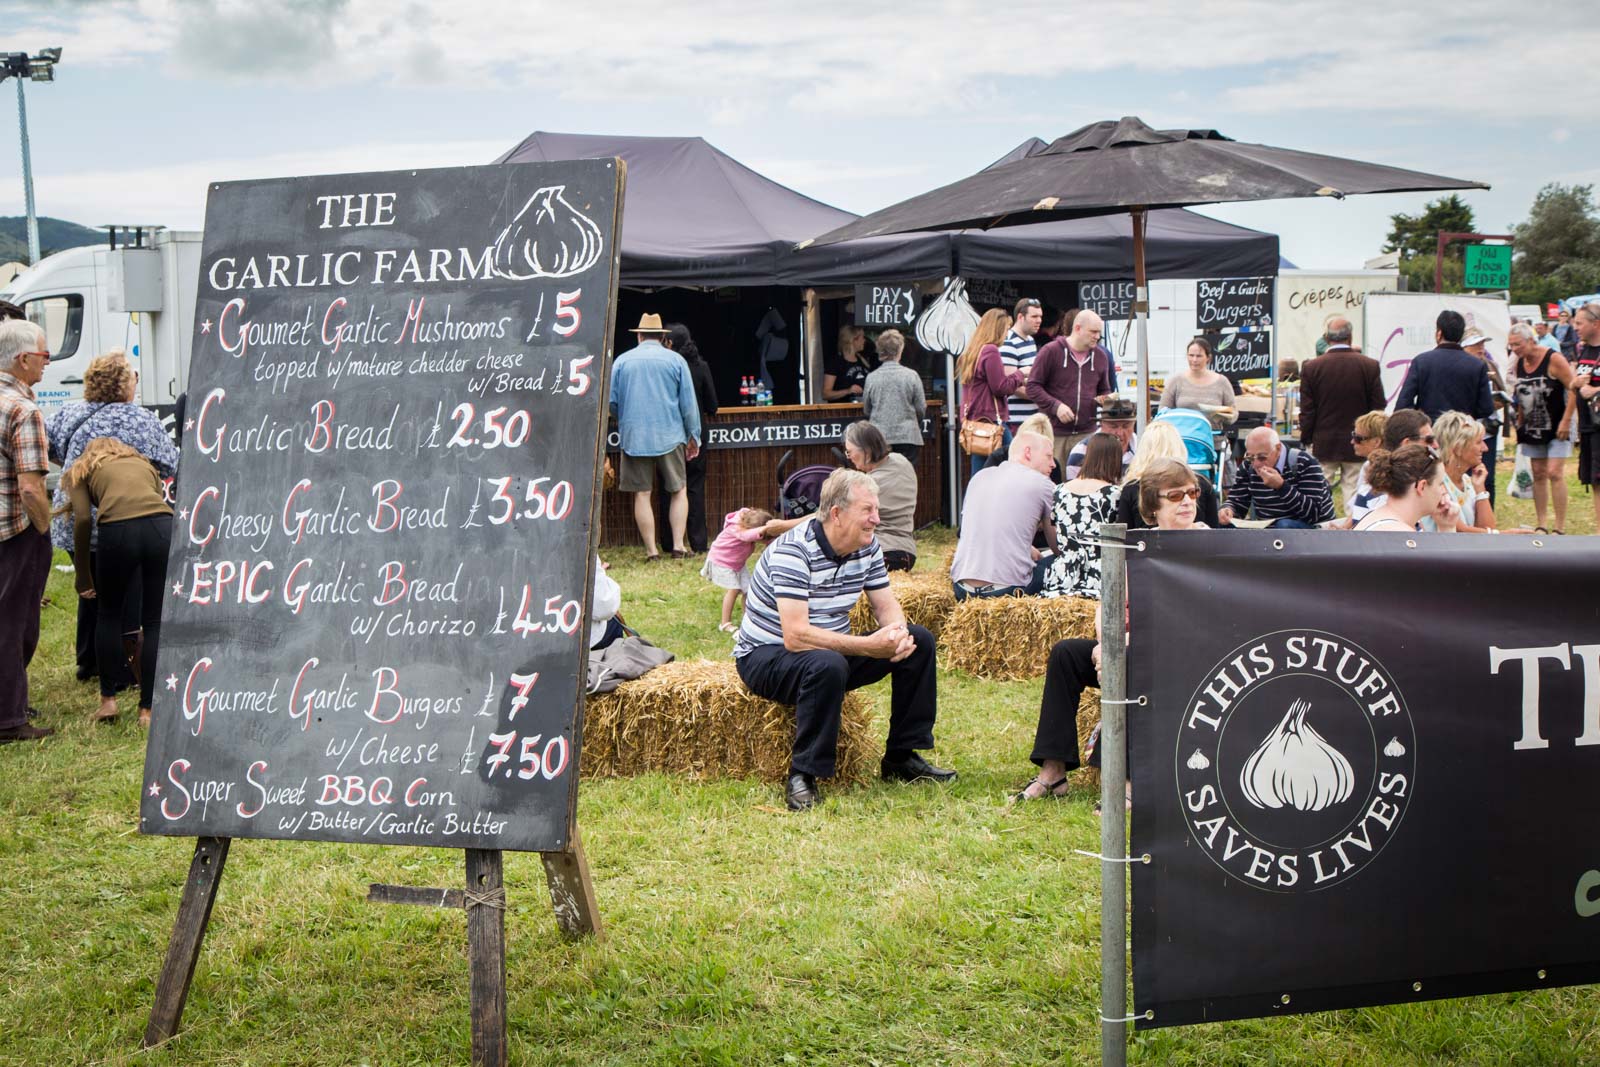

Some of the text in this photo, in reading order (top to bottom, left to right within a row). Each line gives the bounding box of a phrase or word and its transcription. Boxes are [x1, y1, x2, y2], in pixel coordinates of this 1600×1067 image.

[316, 192, 397, 229] THE
[208, 246, 494, 291] GARLIC FARM
[1081, 283, 1134, 301] COLLEC
[1199, 282, 1227, 300] Beef
[1238, 282, 1269, 296] Garlic
[1467, 273, 1508, 286] CIDER
[865, 304, 902, 324] HERE
[872, 286, 902, 305] PAY
[1199, 298, 1263, 325] Burgers
[218, 297, 313, 358] Goumet
[321, 296, 392, 355] Garlic
[394, 296, 512, 346] Mushrooms
[254, 351, 321, 395] topped
[408, 348, 468, 374] chedder
[475, 342, 525, 373] cheese
[196, 388, 292, 463] Garlic
[304, 400, 400, 454] Bread
[419, 401, 532, 450] £2.50
[708, 423, 842, 445] FROM THE ISLE
[188, 482, 273, 553] Cheesy
[283, 478, 361, 545] Garlic
[367, 479, 450, 533] Bread
[459, 475, 575, 529] £3.50
[188, 557, 464, 615] EPIC Garlic Bread
[488, 583, 582, 640] £4.50
[182, 656, 279, 737] Gourmet
[288, 656, 357, 732] Garlic
[364, 666, 464, 729] Burgers
[1188, 636, 1401, 732] THIS STUFF
[455, 726, 570, 781] £7.50
[160, 758, 456, 822] Super Sweet BBQ Corn
[444, 814, 508, 837] Butter
[1185, 771, 1408, 888] SAVES LIVES
